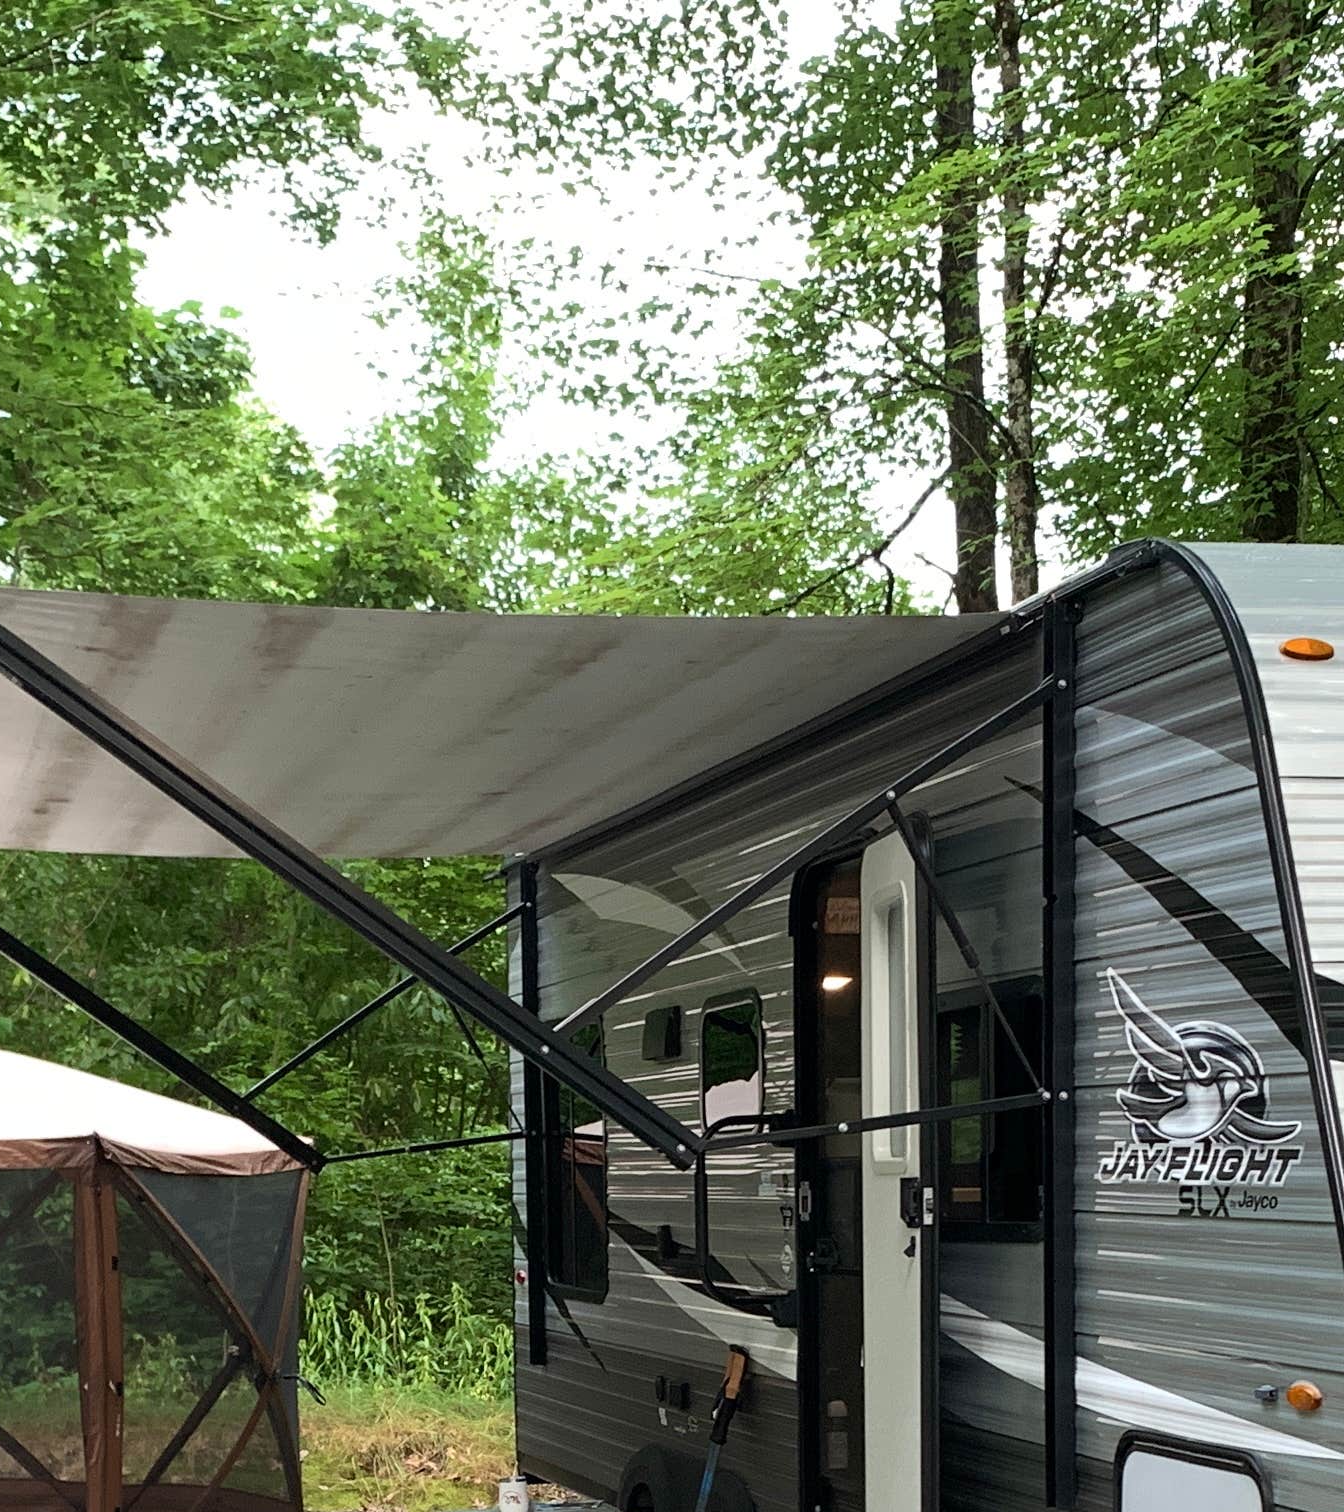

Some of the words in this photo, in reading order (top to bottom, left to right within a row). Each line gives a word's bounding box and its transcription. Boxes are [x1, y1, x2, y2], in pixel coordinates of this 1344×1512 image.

[1160, 1144, 1304, 1187] FLIGHT
[1178, 1185, 1231, 1218] SLX
[1238, 1190, 1278, 1213] Jayco
